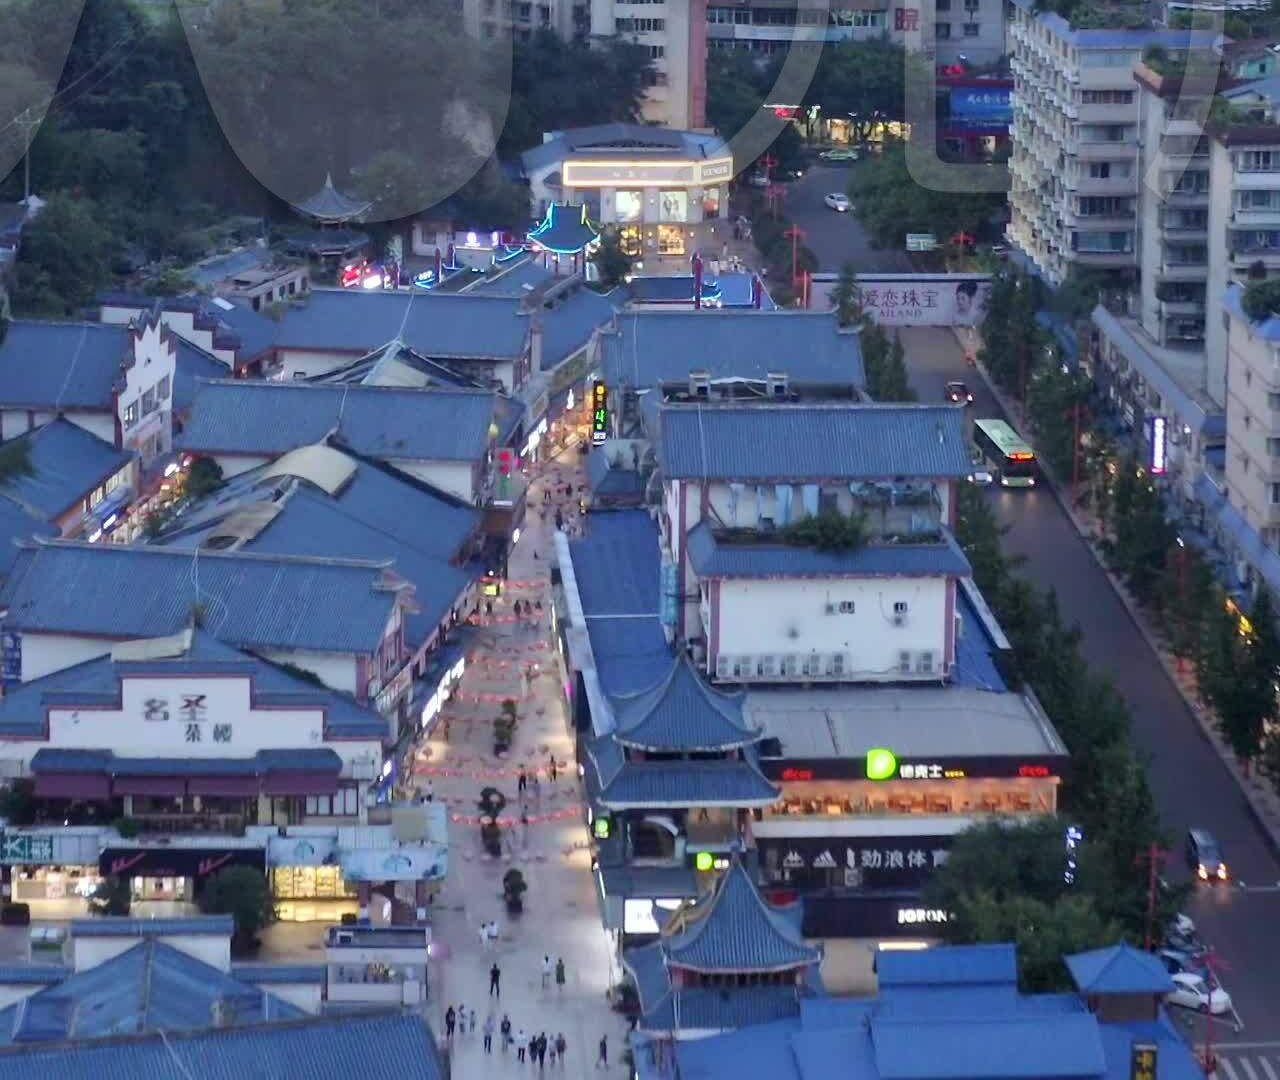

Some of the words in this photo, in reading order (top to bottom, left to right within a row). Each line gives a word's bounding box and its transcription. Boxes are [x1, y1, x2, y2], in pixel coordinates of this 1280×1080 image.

[862, 287, 939, 309] 爱恋珠宝
[899, 764, 942, 779] 德克士
[860, 848, 951, 869] 劲浪体育
